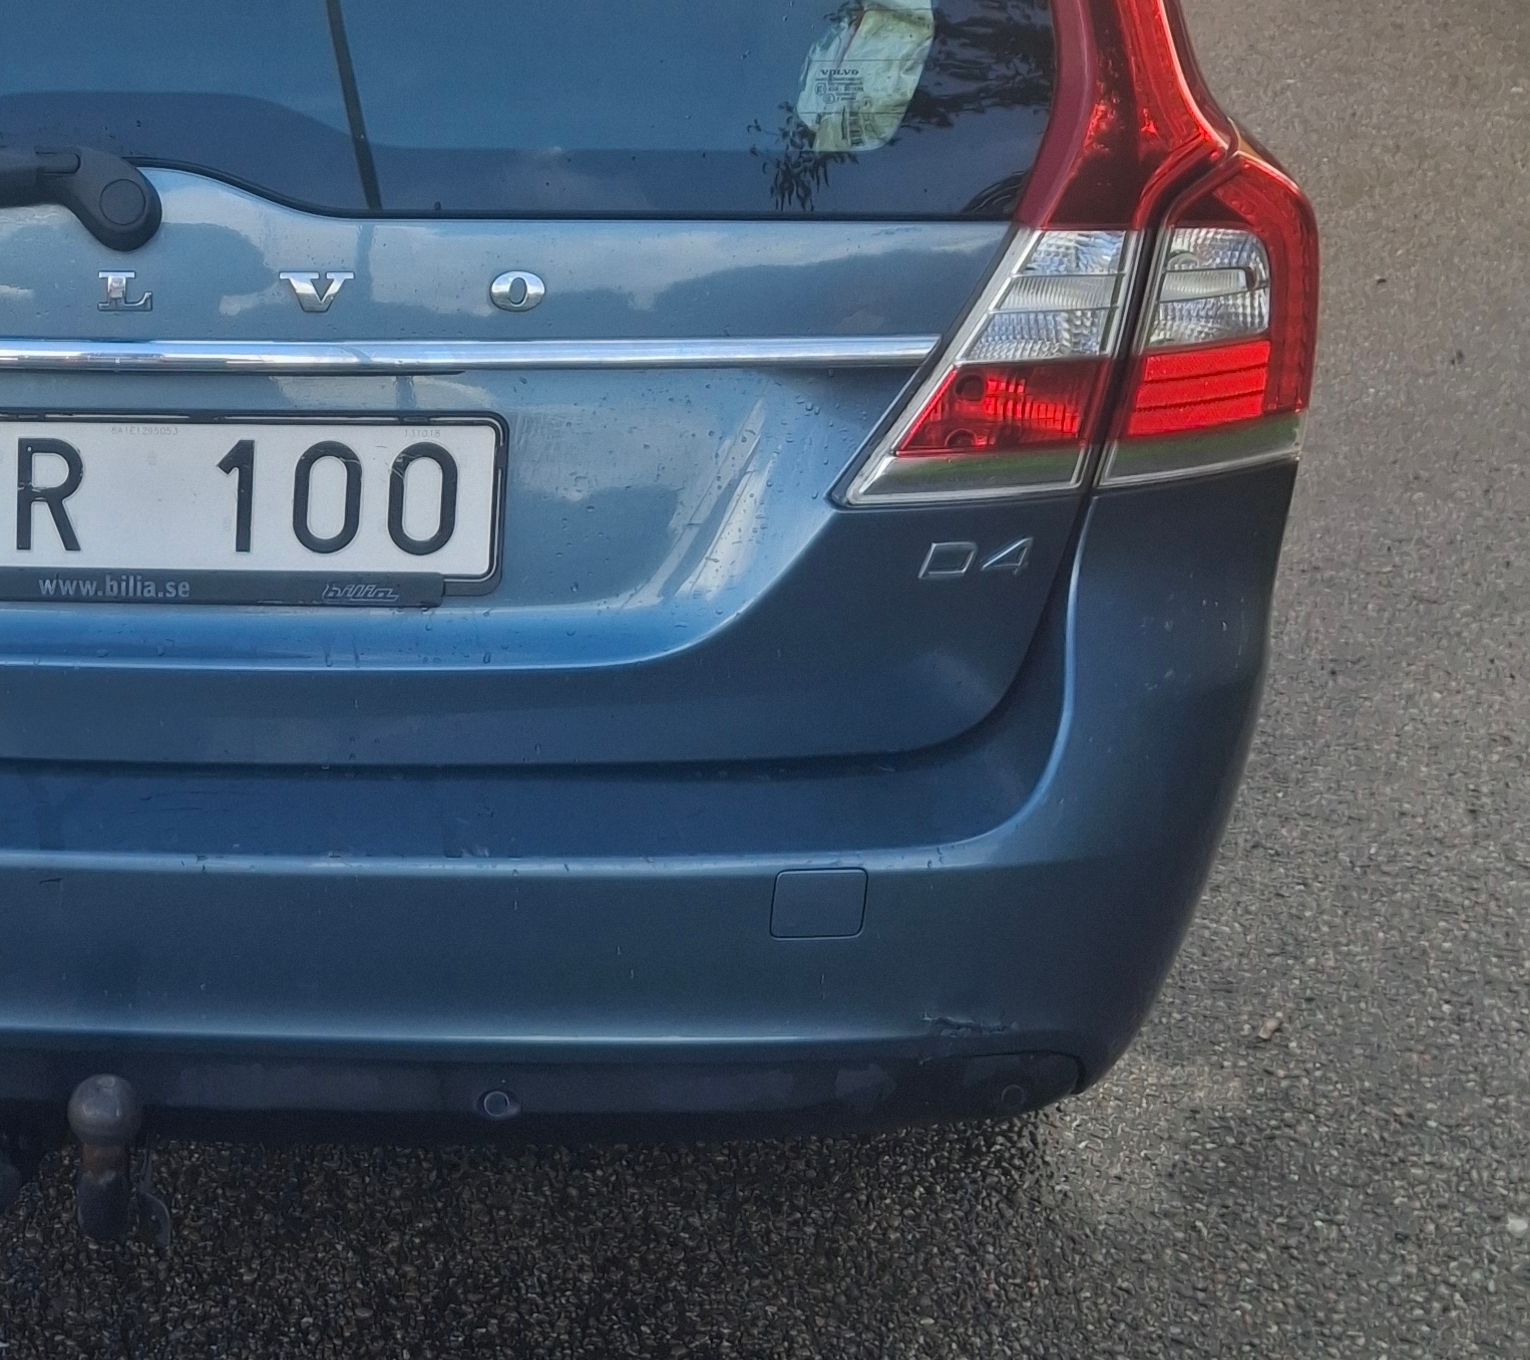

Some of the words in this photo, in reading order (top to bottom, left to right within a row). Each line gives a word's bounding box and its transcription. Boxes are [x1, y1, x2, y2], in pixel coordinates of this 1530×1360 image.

[215, 439, 458, 556] 100
[918, 537, 1034, 580] D4
[38, 575, 190, 598] www.bilia.se
